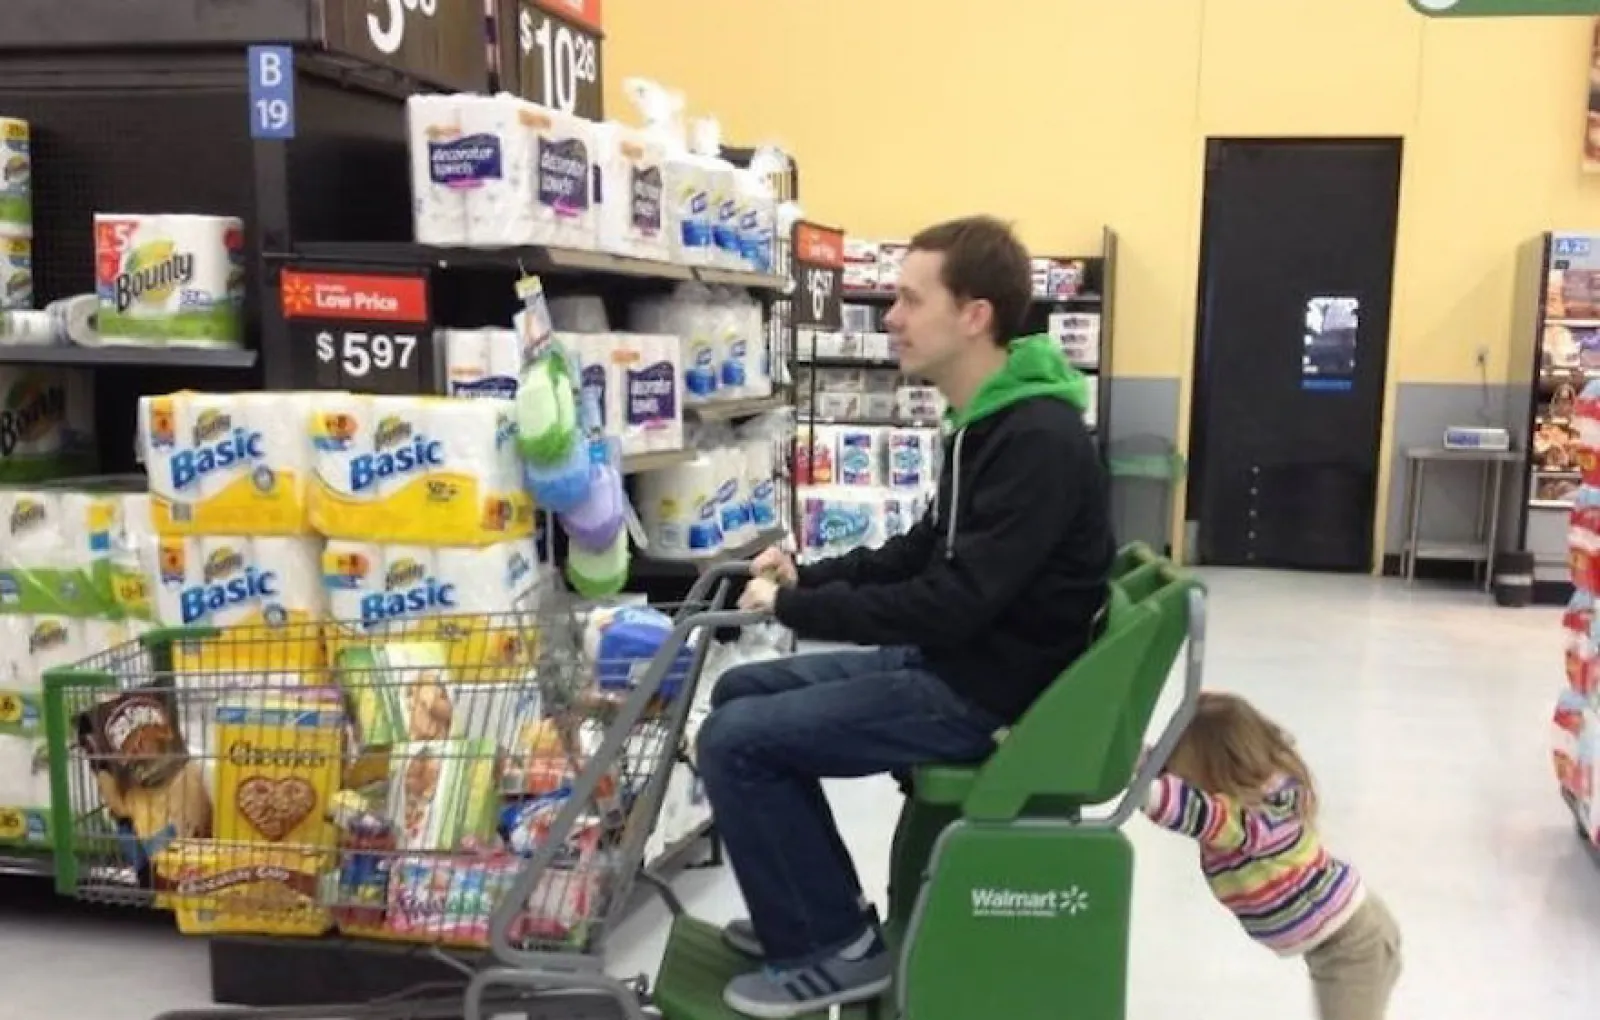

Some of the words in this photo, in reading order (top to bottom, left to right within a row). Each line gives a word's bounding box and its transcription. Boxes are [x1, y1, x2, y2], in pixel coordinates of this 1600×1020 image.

[262, 52, 282, 87] B
[256, 99, 289, 131] 19
[117, 251, 194, 314] Bounty
[315, 287, 351, 308] Low
[354, 292, 399, 312] Price
[170, 426, 265, 489] Basic
[349, 434, 444, 491] Basic
[181, 565, 281, 623] Basic
[361, 575, 455, 628] Basic
[970, 887, 1058, 909] Walmart
